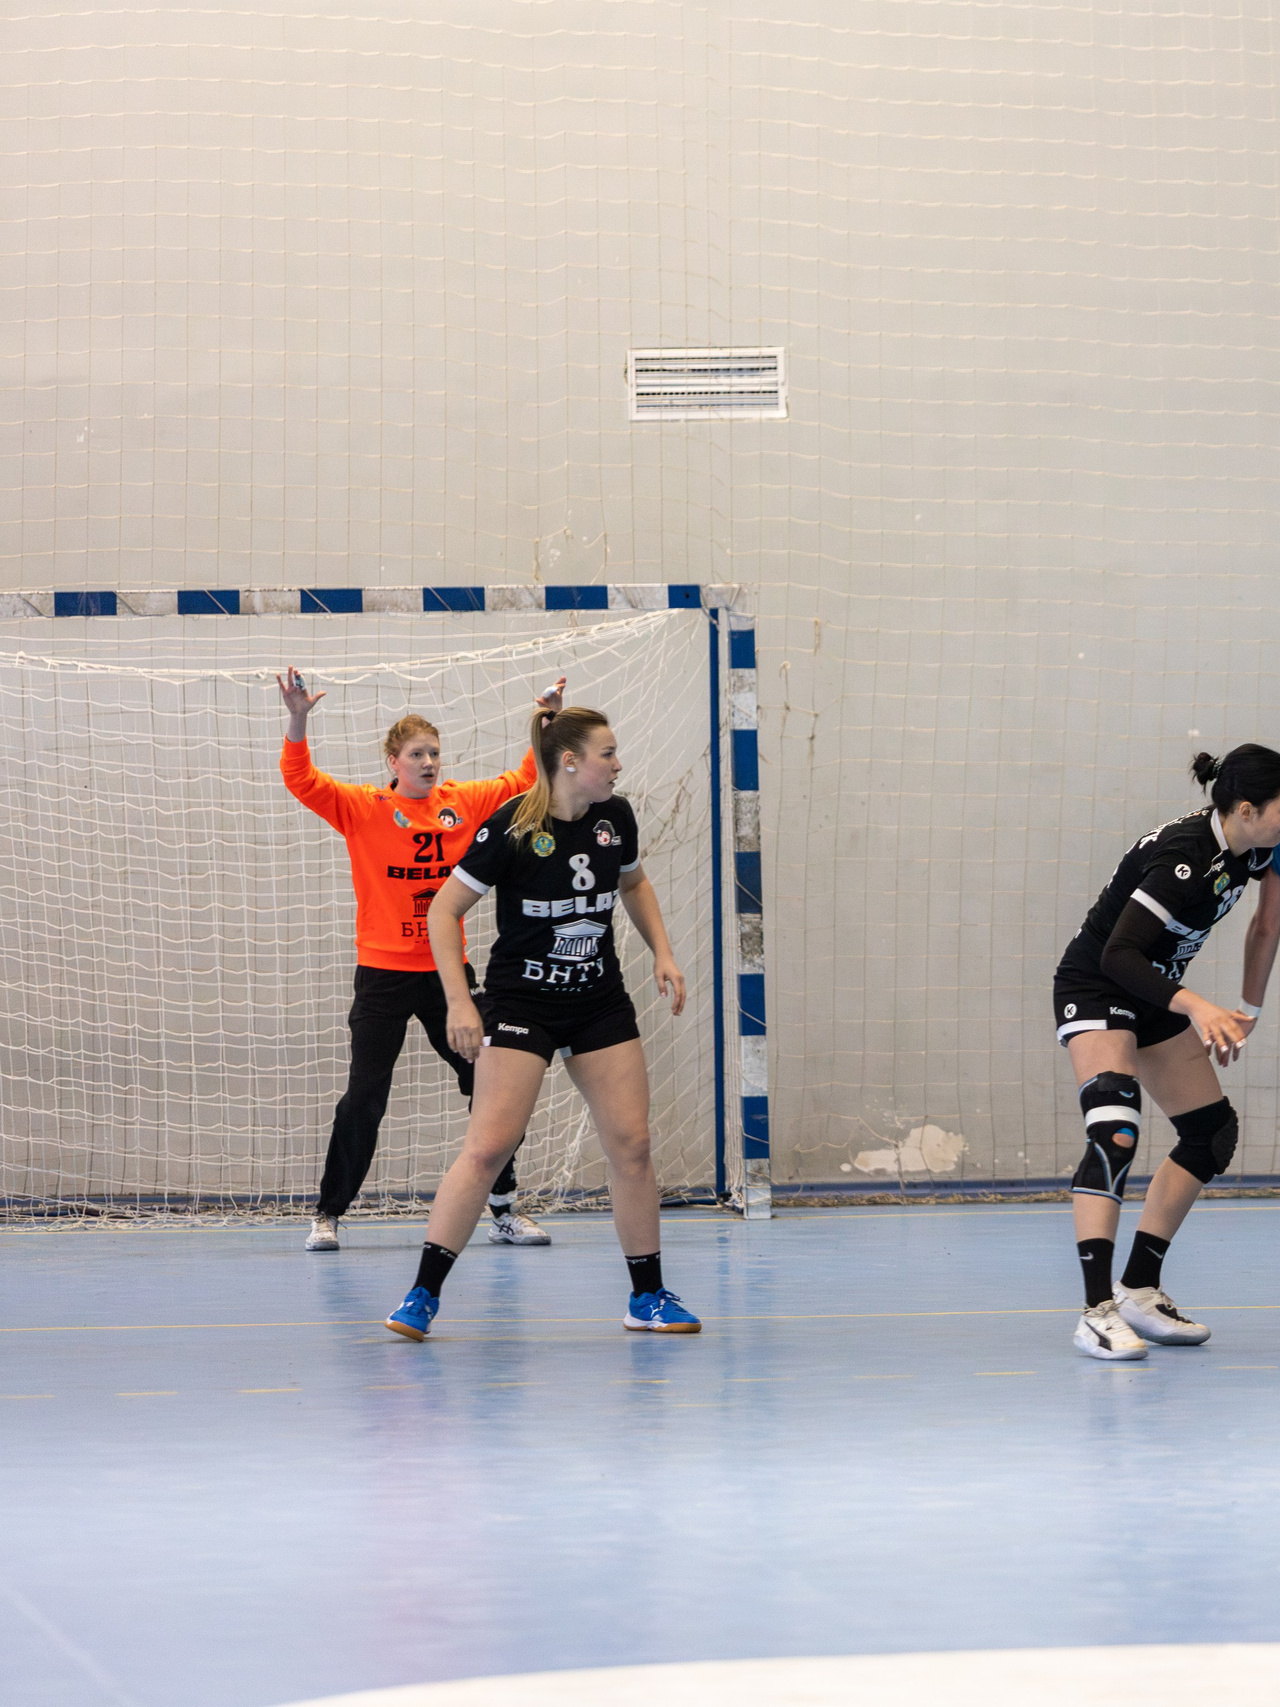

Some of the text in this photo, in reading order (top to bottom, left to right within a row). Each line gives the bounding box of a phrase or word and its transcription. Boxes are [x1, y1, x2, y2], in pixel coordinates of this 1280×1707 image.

[412, 832, 445, 863] 21
[387, 865, 456, 880] BELA
[568, 853, 596, 891] 8
[498, 1022, 529, 1035] Kempa
